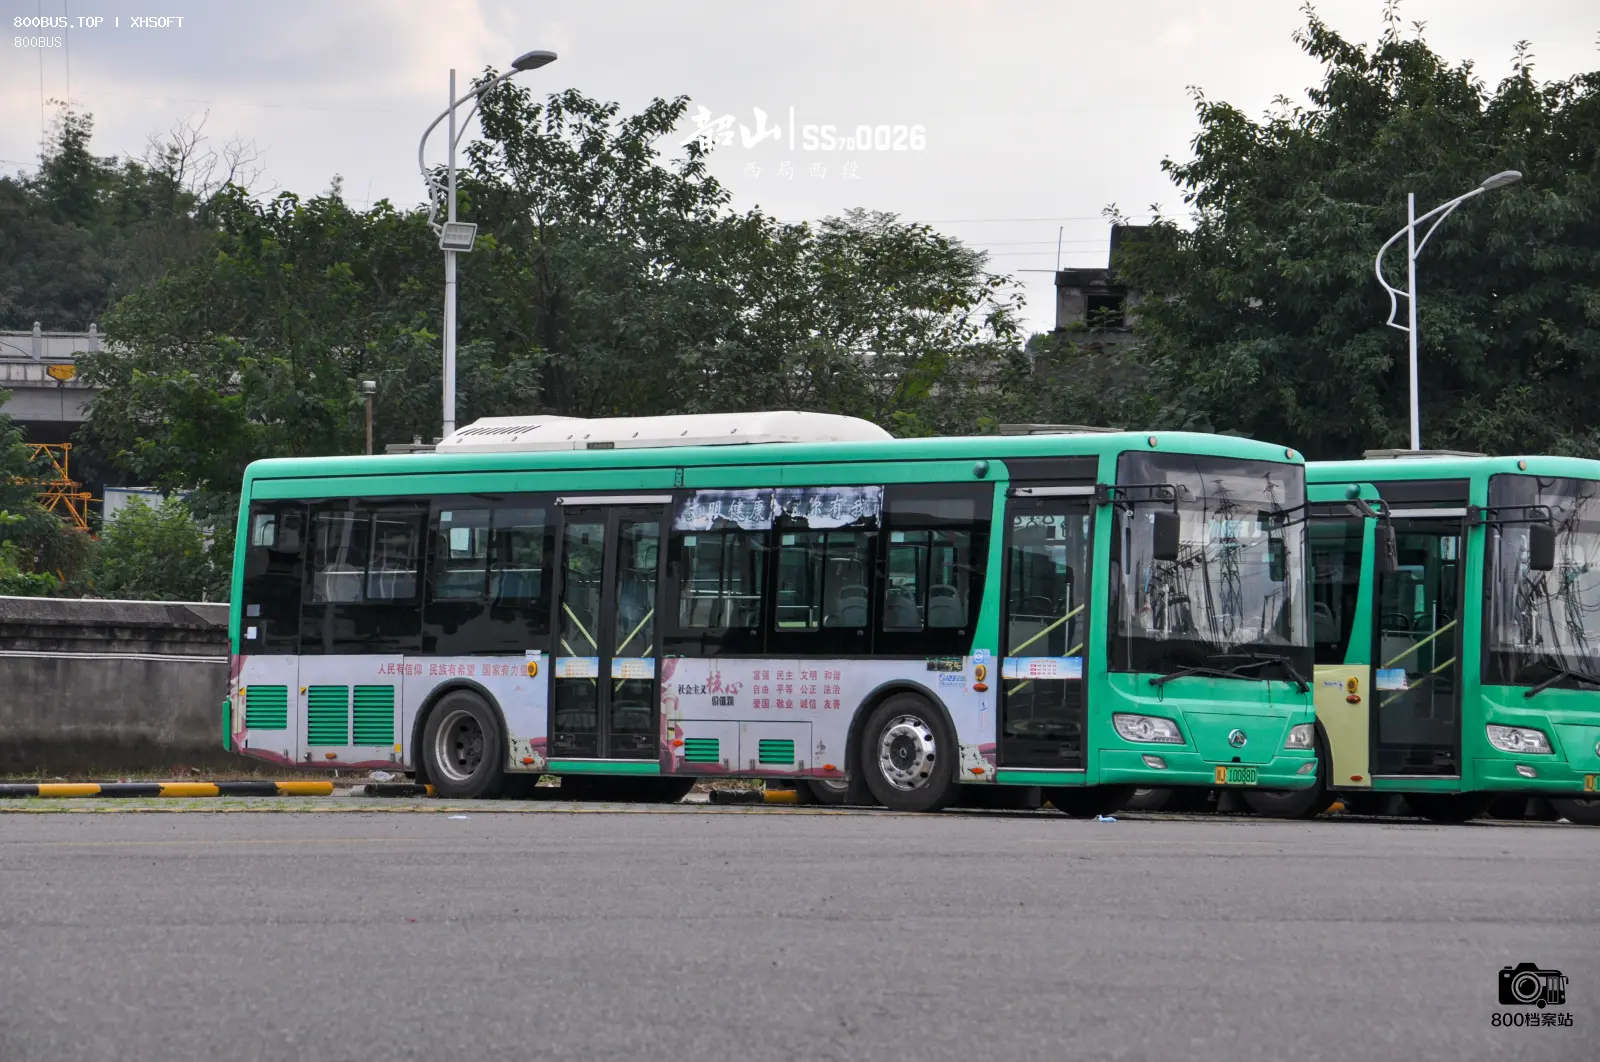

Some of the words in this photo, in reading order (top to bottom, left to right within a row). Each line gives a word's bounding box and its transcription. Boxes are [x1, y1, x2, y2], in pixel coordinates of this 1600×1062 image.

[377, 662, 423, 676] 人民有信仰
[429, 663, 475, 677] 民族有希望
[753, 670, 770, 681] 富强
[776, 670, 793, 681] 民主
[800, 670, 817, 681] 文明
[823, 670, 841, 681] 和谐
[678, 684, 706, 695] 社会主义
[753, 684, 770, 695] 自由
[776, 684, 793, 695] 平等
[800, 684, 817, 695] 公正
[823, 684, 841, 695] 法治
[753, 698, 770, 709] 爱国
[776, 698, 793, 709] 敬业
[800, 698, 817, 709] 诚信
[823, 698, 841, 709] 友善
